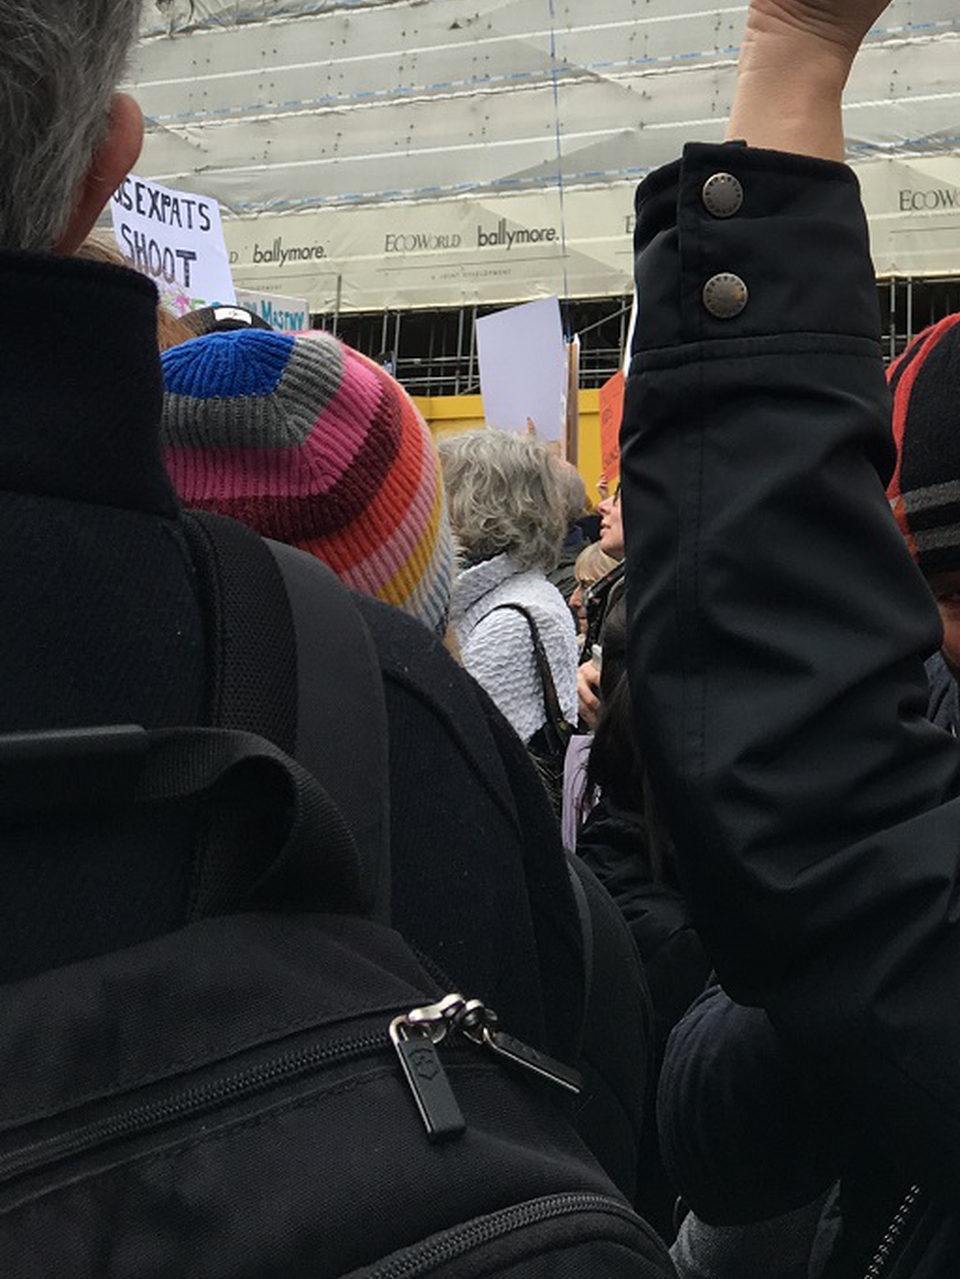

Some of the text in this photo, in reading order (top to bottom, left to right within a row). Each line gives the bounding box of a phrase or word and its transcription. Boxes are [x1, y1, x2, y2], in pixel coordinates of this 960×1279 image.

[135, 182, 211, 231] EXPATS
[253, 236, 327, 268] ballymore.
[477, 218, 560, 250] ballymore.
[121, 223, 197, 288] SHOOT
